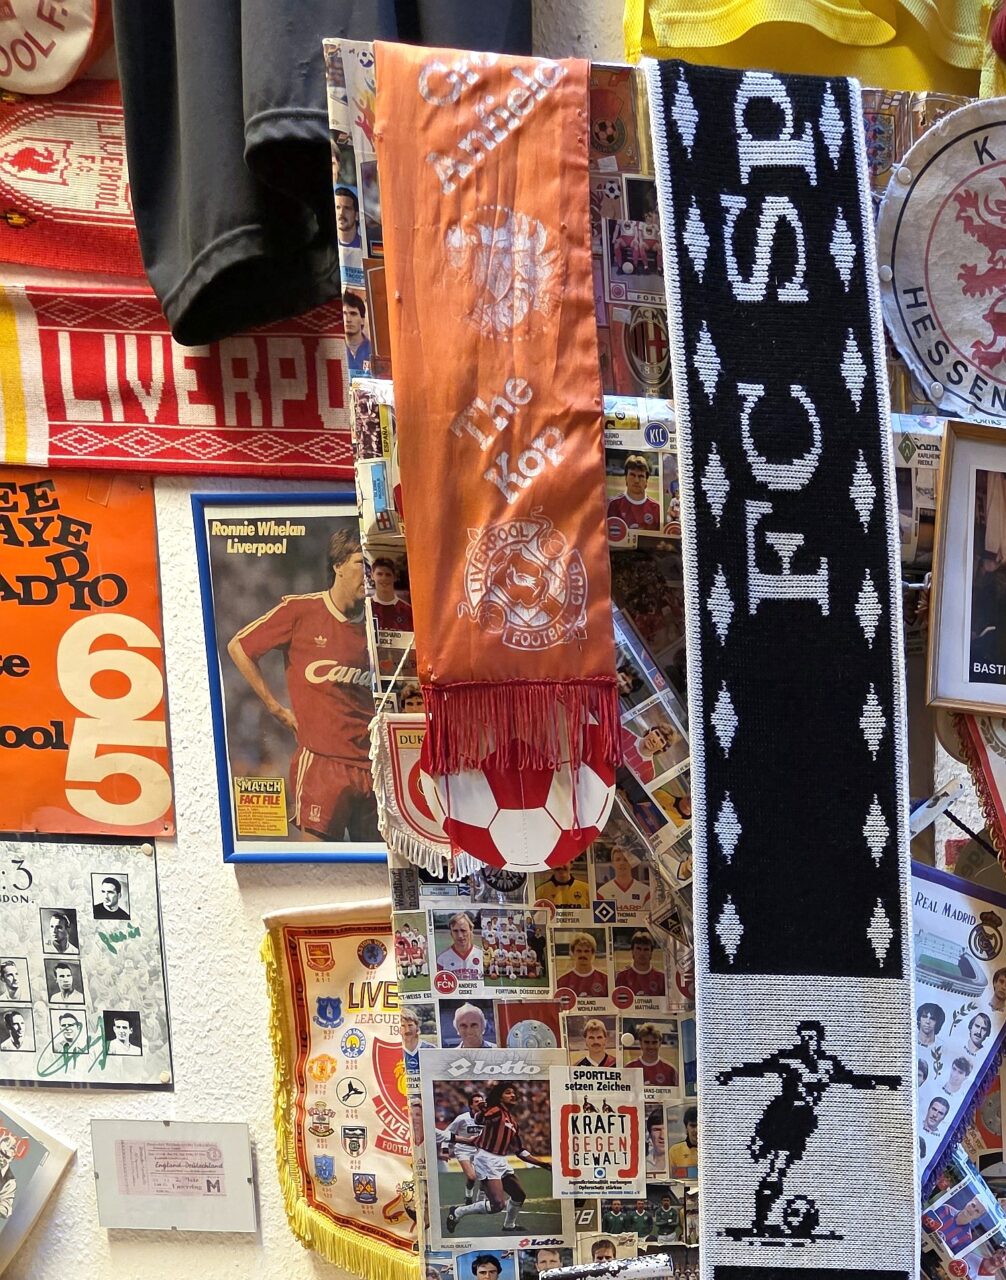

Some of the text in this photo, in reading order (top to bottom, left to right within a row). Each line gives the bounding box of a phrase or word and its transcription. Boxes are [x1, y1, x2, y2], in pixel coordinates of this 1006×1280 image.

[450, 376, 533, 452] The
[484, 426, 566, 505] Kop
[211, 521, 306, 537] Ronnie Whelan
[226, 539, 287, 557] Liverpool
[469, 523, 530, 594] LIVERPOOL
[240, 780, 282, 794] MATCH
[239, 795, 281, 806] FACT FILE
[914, 892, 977, 926] REAL MADRID
[436, 980, 455, 988] FCN
[473, 1058, 541, 1075] lotto
[573, 1070, 622, 1081] SPORTLER
[565, 1081, 631, 1092] setzen Zeichen
[571, 1115, 627, 1135] KRAFT
[572, 1135, 628, 1153] GEGEN
[573, 1152, 628, 1166] GEWALT
[530, 1238, 564, 1247] lotto
